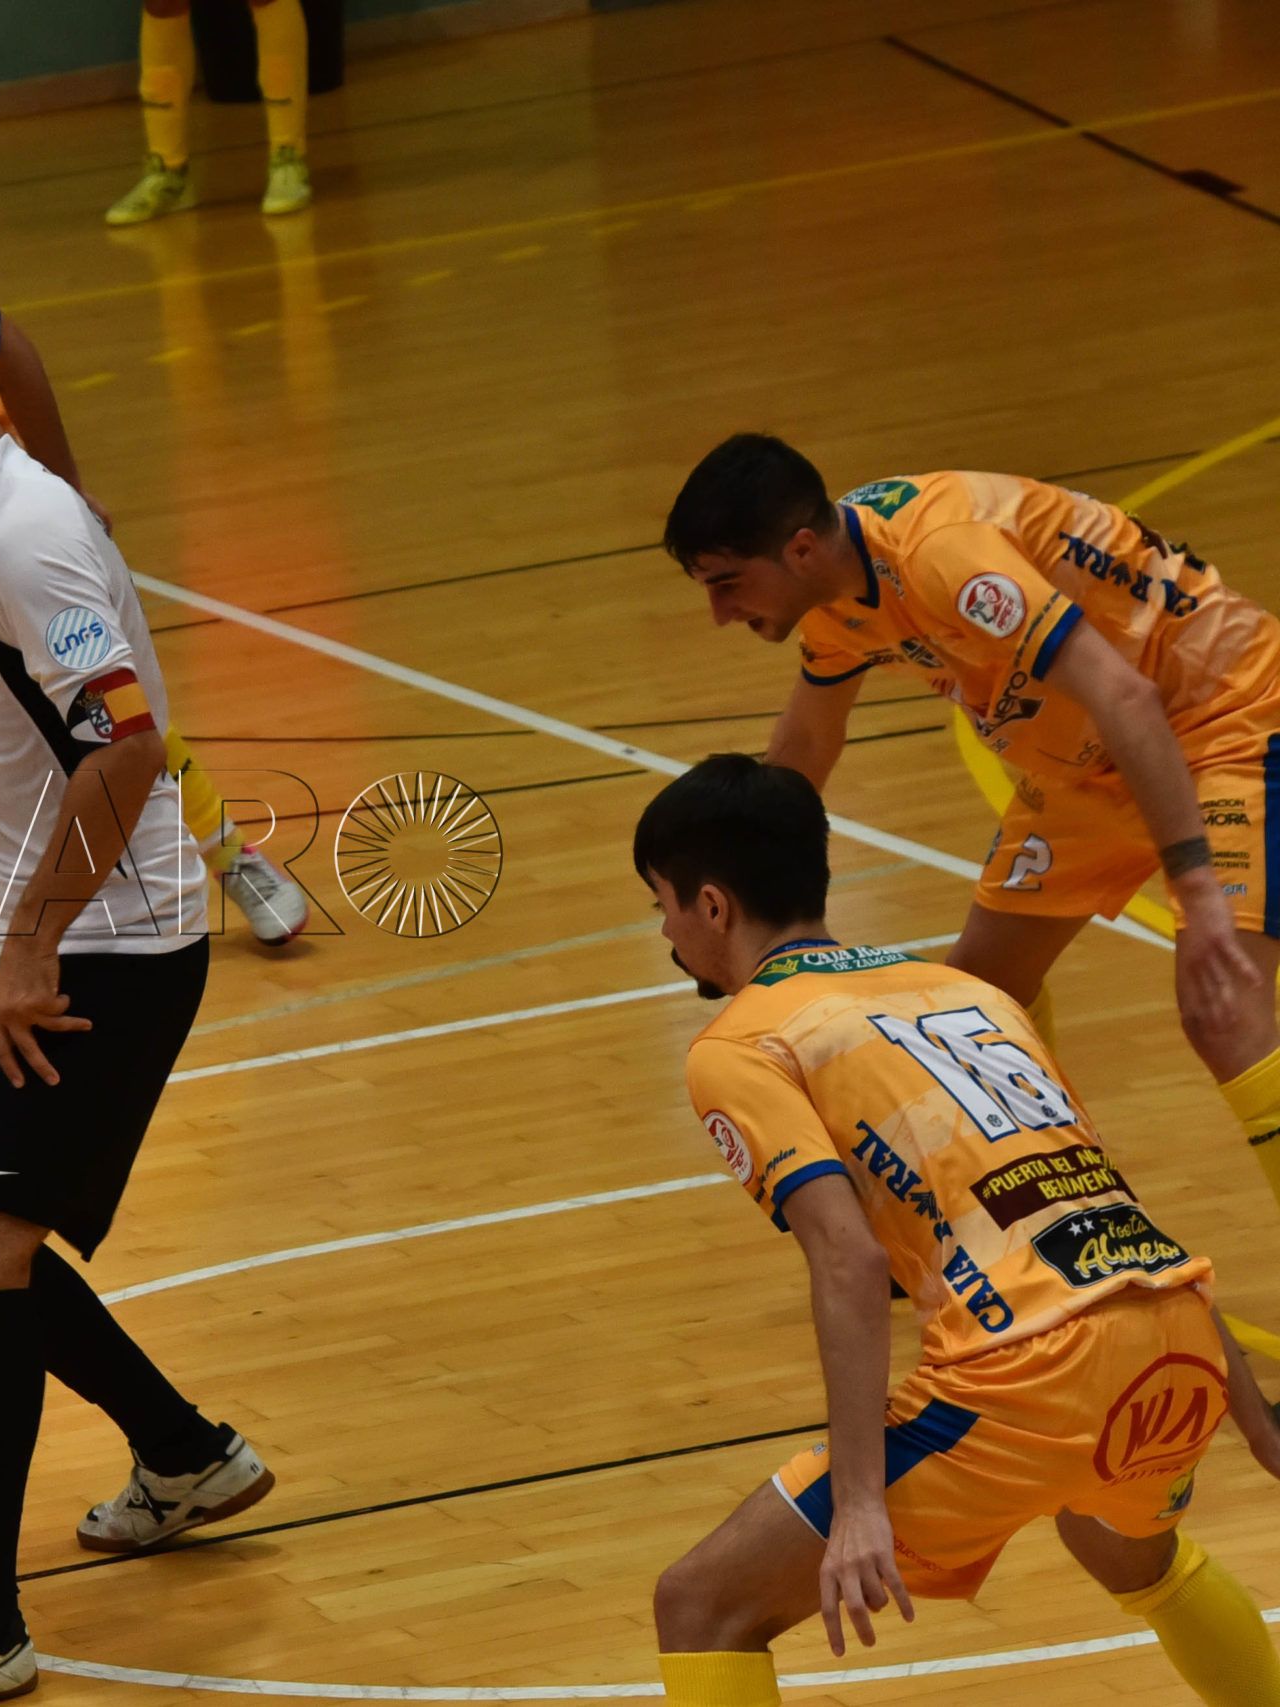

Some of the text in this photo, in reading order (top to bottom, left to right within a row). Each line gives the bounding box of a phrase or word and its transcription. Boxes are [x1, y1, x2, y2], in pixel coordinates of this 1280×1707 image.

[803, 949, 855, 966] CAJA
[831, 952, 908, 972] DE ZAMORA
[982, 1158, 1050, 1199] #PUERTA
[942, 1244, 1014, 1333] CAJA
[1120, 1386, 1209, 1469] KIA
